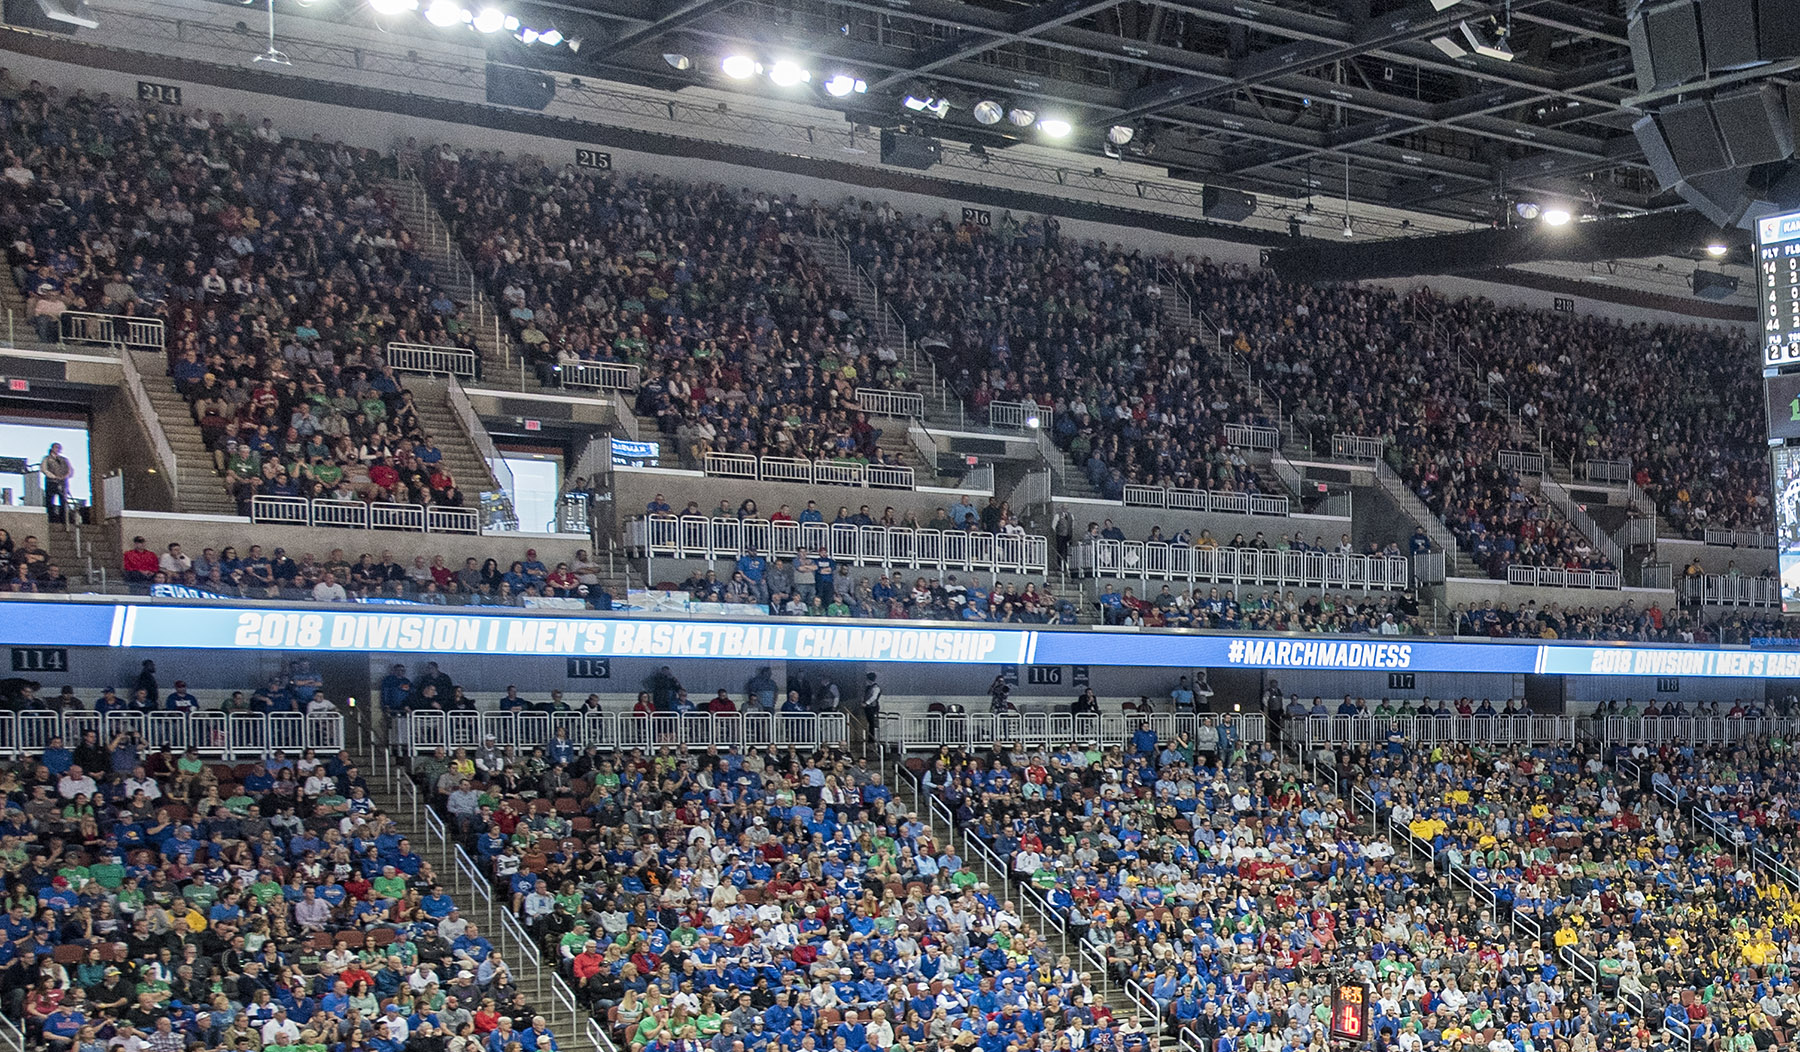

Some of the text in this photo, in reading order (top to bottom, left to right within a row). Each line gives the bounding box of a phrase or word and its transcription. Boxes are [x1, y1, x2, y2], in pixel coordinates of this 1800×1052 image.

[142, 85, 177, 104] 214
[580, 151, 608, 168] 215
[965, 210, 989, 224] 216
[1762, 247, 1779, 259] PLY
[1785, 244, 1800, 255] FLS
[1763, 261, 1777, 274] 14
[1789, 258, 1797, 270] 0
[1769, 290, 1776, 302] 4
[1556, 299, 1573, 311] 218
[1766, 319, 1780, 331] 44
[1771, 346, 1779, 359] 2
[1791, 343, 1799, 356] 3
[235, 612, 996, 663] 2018 DIVISION I MEN'S BASKETBALL CHAMPIONSHIP
[17, 651, 61, 670] 114
[1227, 640, 1412, 668] #MARCHMADNESS
[575, 659, 606, 677] 115
[1590, 650, 1632, 673] 2018
[1634, 651, 1704, 675] DIVISION
[1706, 652, 1714, 675] I
[1033, 667, 1059, 683] 116
[1391, 674, 1413, 688] 117
[1659, 679, 1677, 692] 118
[1344, 1006, 1359, 1034] 16
